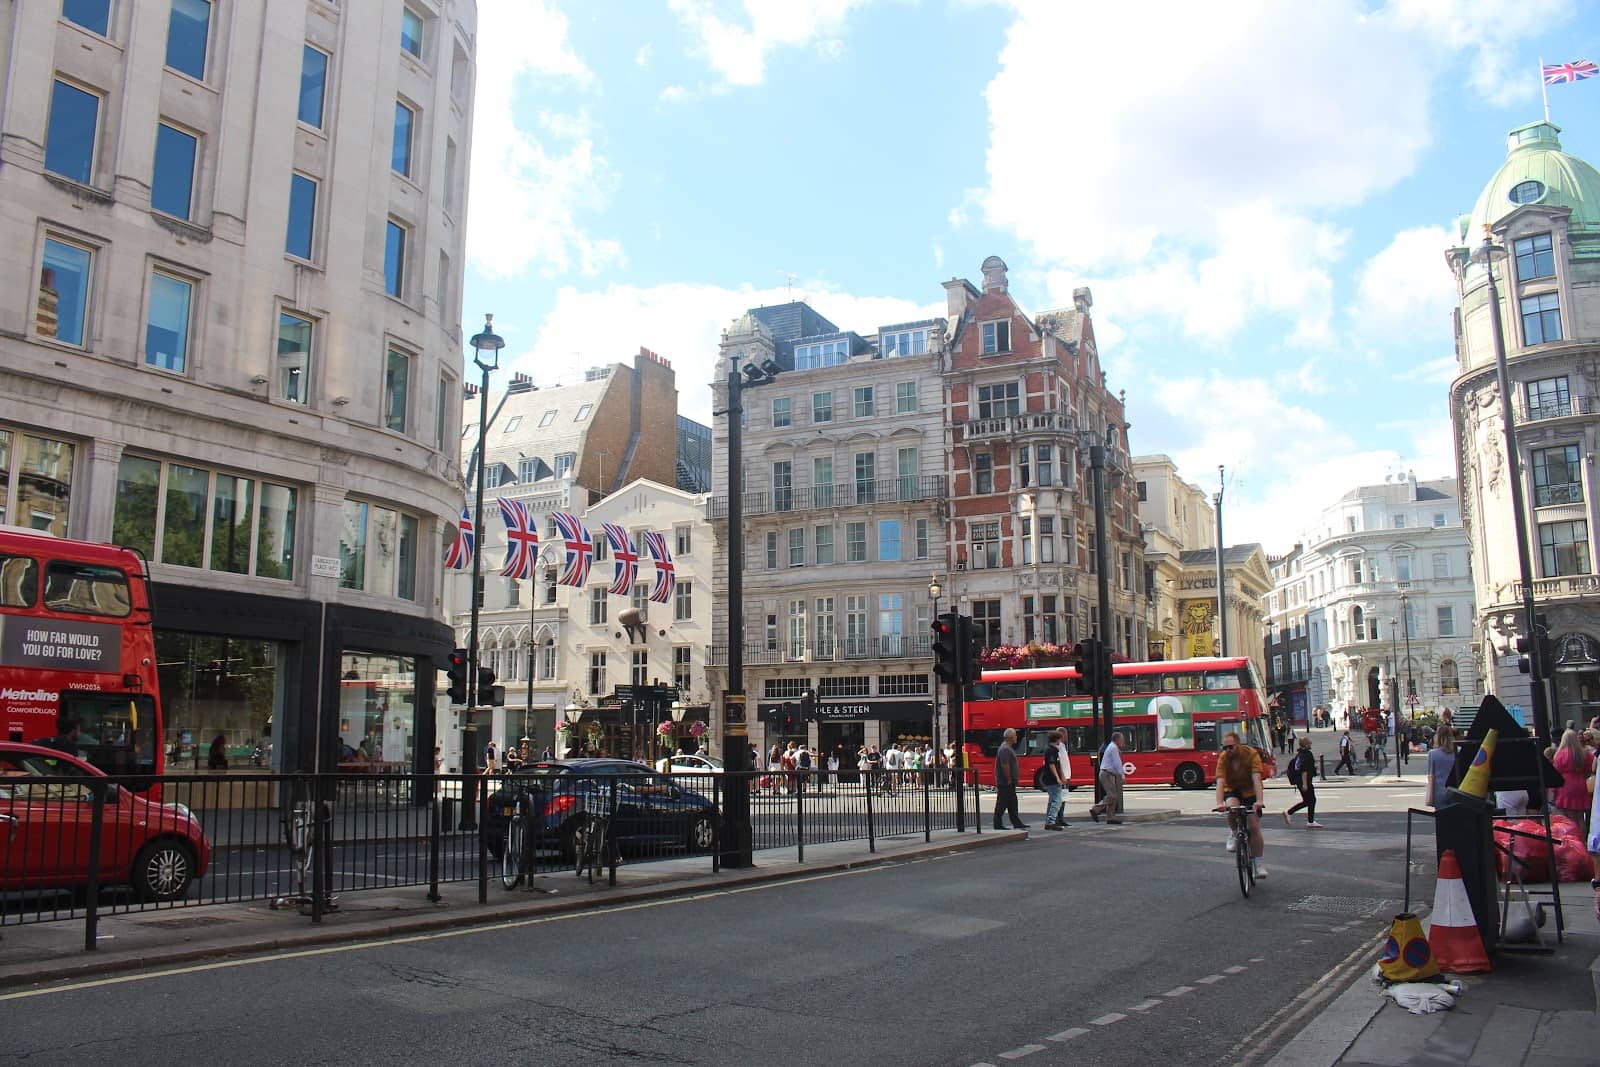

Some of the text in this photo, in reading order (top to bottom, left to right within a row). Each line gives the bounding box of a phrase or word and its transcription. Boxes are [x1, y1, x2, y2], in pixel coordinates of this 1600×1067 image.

[1180, 579, 1217, 589] LYCEU
[27, 629, 99, 647] HOW FAR WOULD
[23, 643, 102, 661] YOU GO FOR LOVE?
[0, 688, 60, 701] Metroline
[833, 706, 840, 714] &
[842, 705, 870, 714] STEEN
